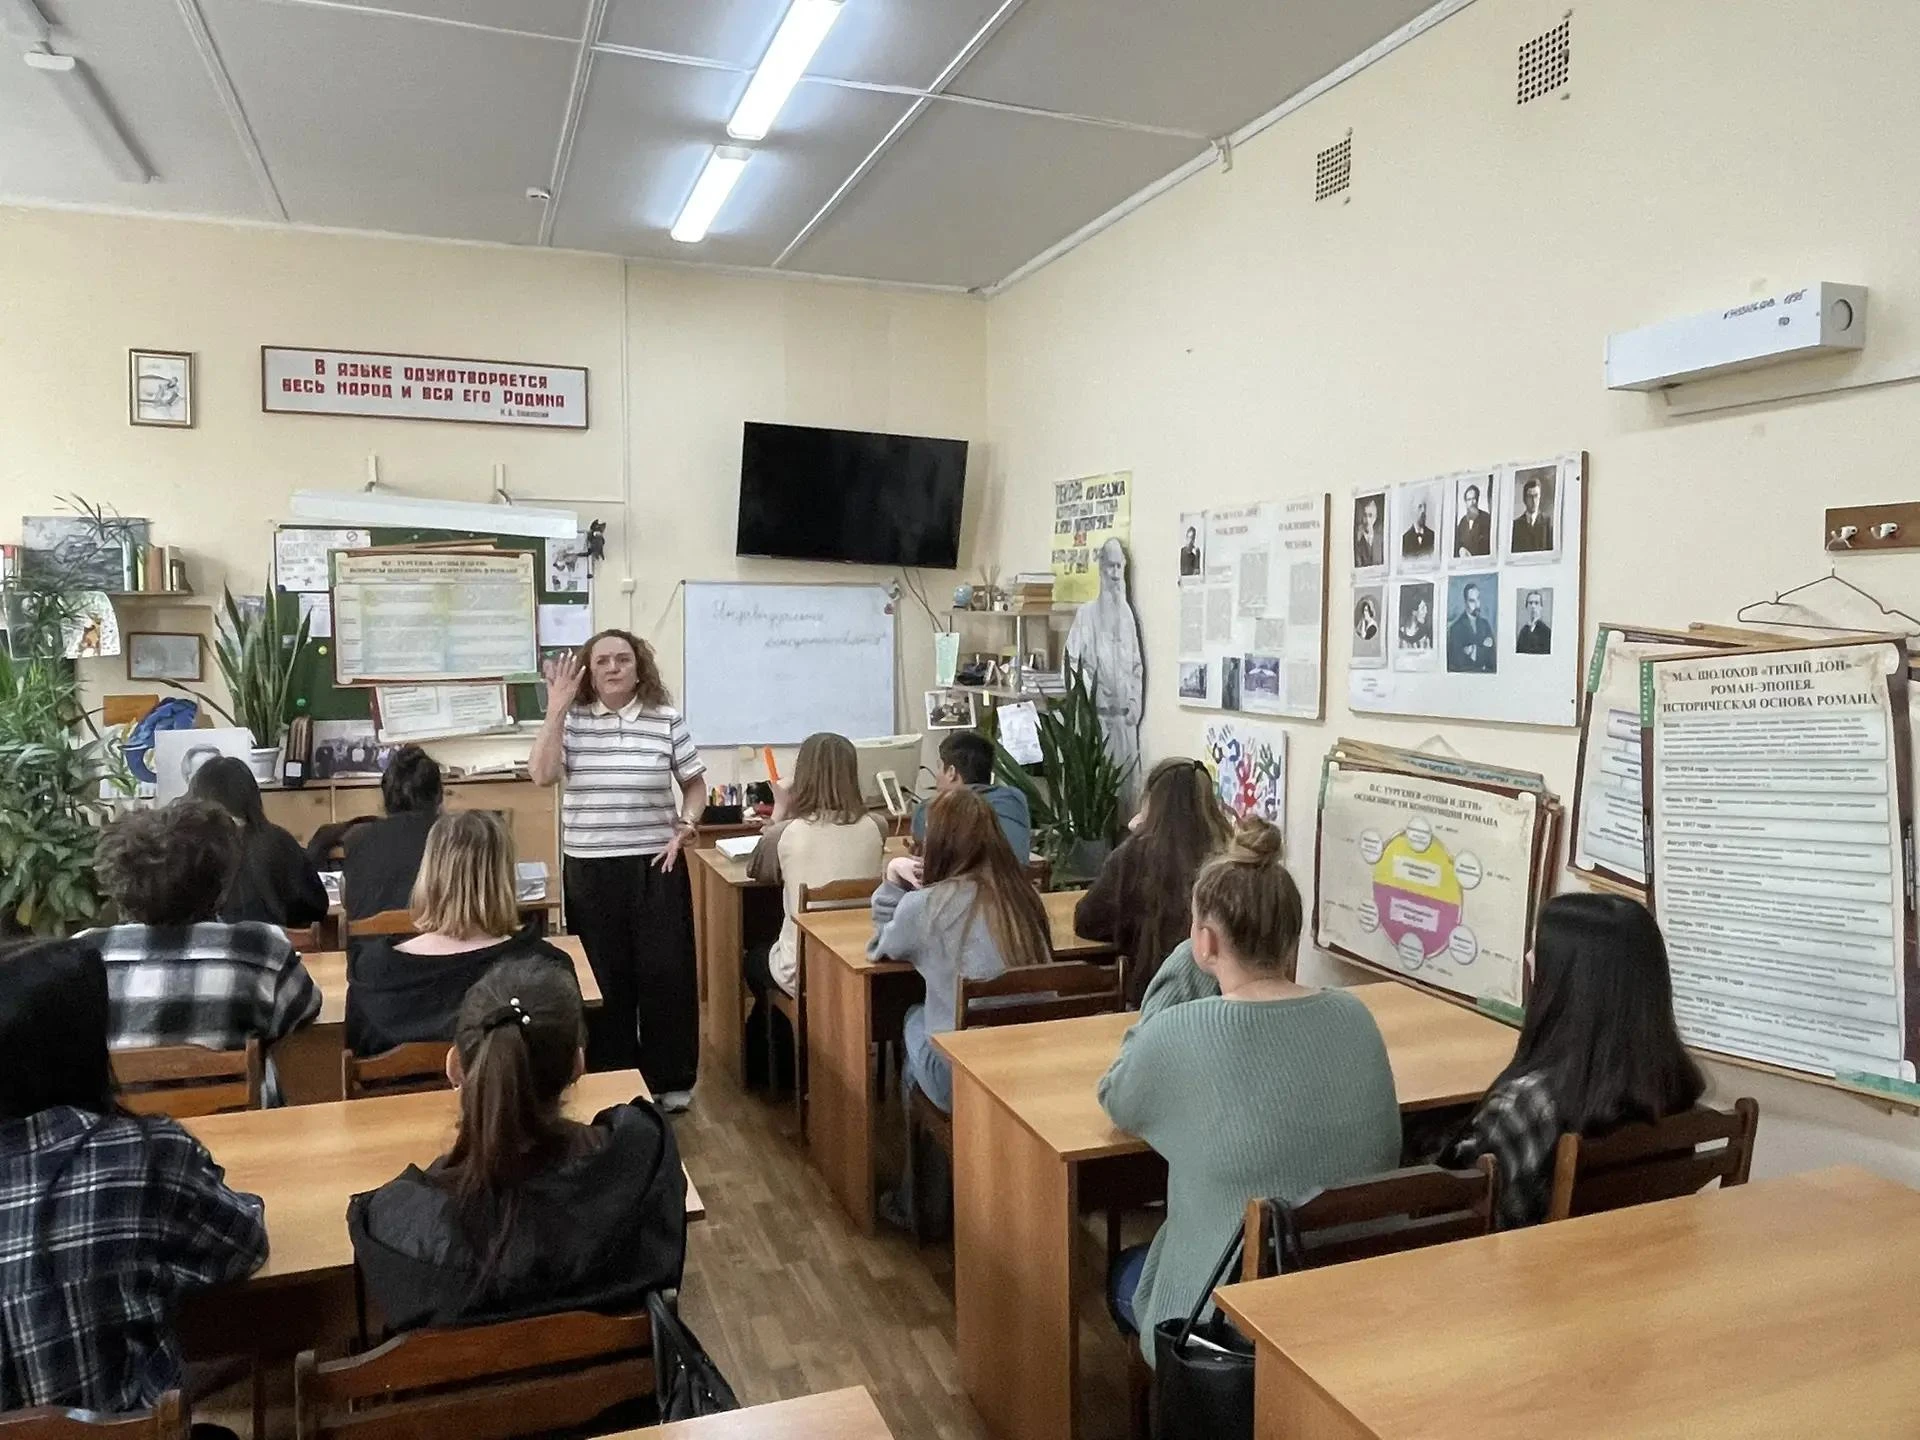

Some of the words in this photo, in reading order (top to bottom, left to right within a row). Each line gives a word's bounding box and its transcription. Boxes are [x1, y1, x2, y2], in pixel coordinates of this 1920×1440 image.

[314, 358, 326, 375] В
[403, 366, 548, 389] ОДУХОТВОРЯЕТСЯ
[282, 377, 326, 394] ВЕСЬ
[336, 380, 392, 399] НАРОД
[401, 385, 412, 399] И
[422, 386, 454, 402] ВСЯ
[462, 389, 491, 404] ЕГО
[503, 390, 565, 408] РОДИНА
[1698, 666, 1758, 681] ШОЛОХОВ
[1761, 659, 1812, 676] «ТИХИЙ
[1814, 659, 1851, 674] ДОН»
[1663, 699, 1757, 713] ИСТОРИЧЕСКАЯ
[1760, 697, 1814, 710] ОСНОВА
[1816, 692, 1879, 706] РОМАНА
[1463, 812, 1499, 828] РОМАНА
